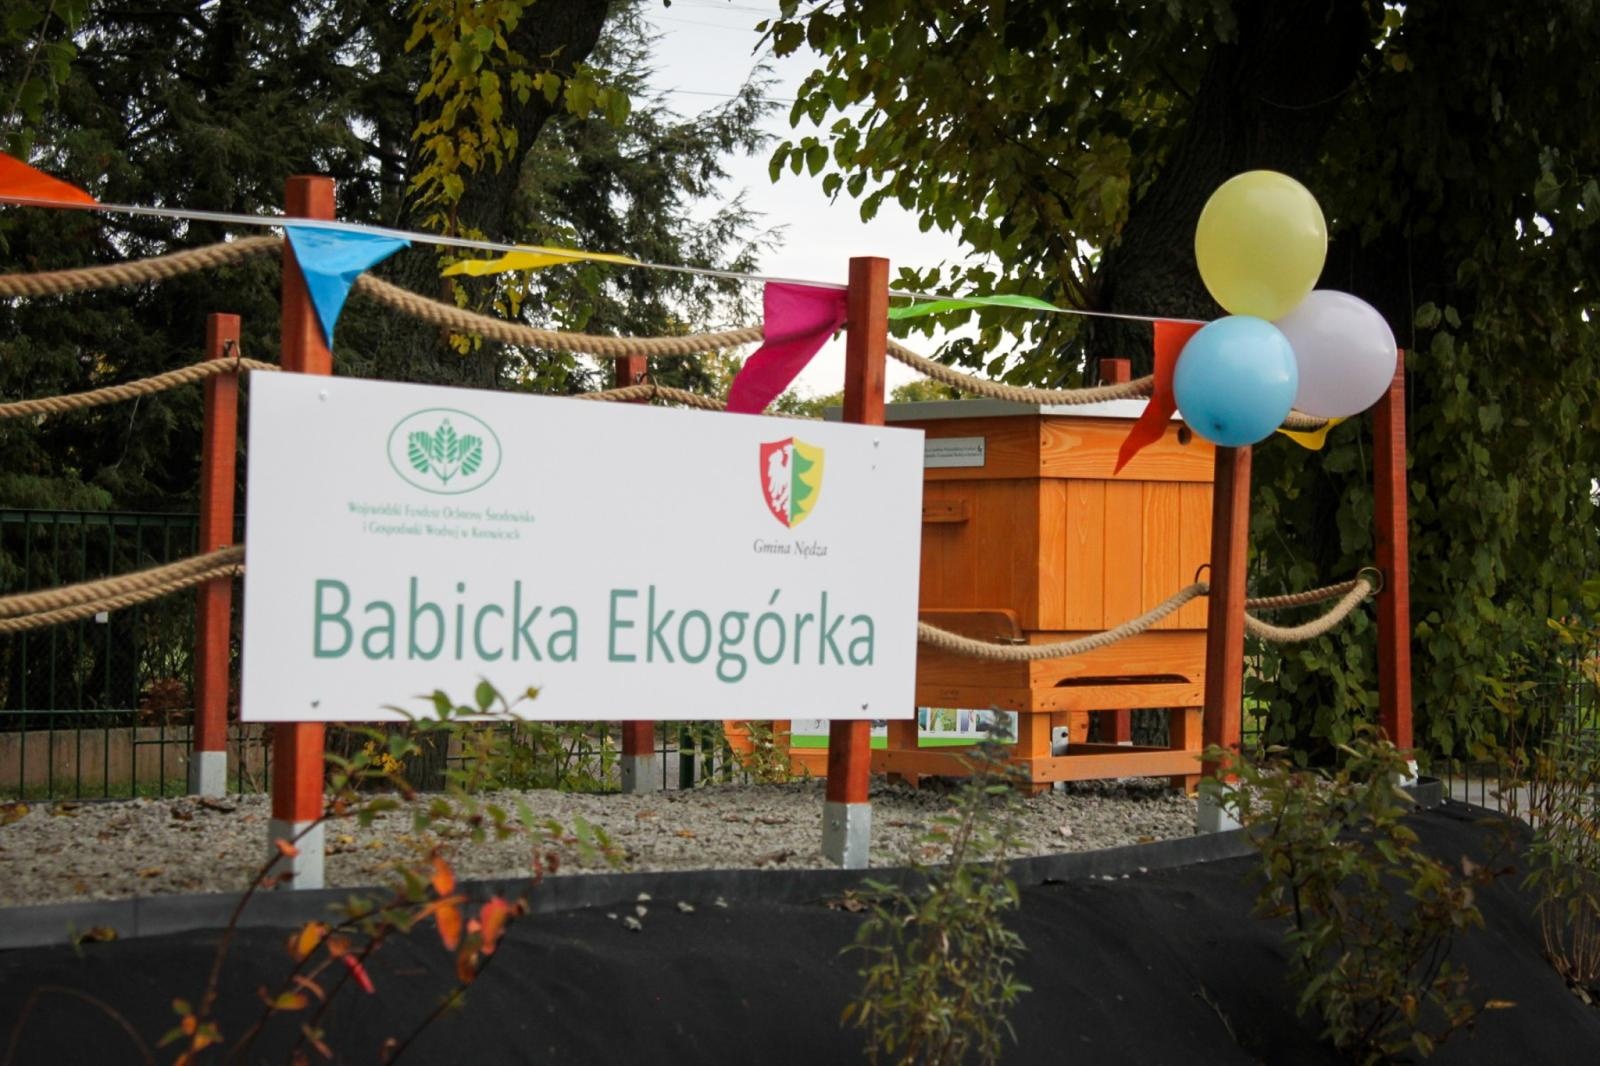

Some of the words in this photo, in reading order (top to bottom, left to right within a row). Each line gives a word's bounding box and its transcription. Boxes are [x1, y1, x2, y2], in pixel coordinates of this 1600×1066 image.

[753, 538, 791, 555] Gmina
[794, 540, 828, 560] Nędza
[313, 576, 579, 662] Babicka
[607, 584, 876, 684] Ekogórka
